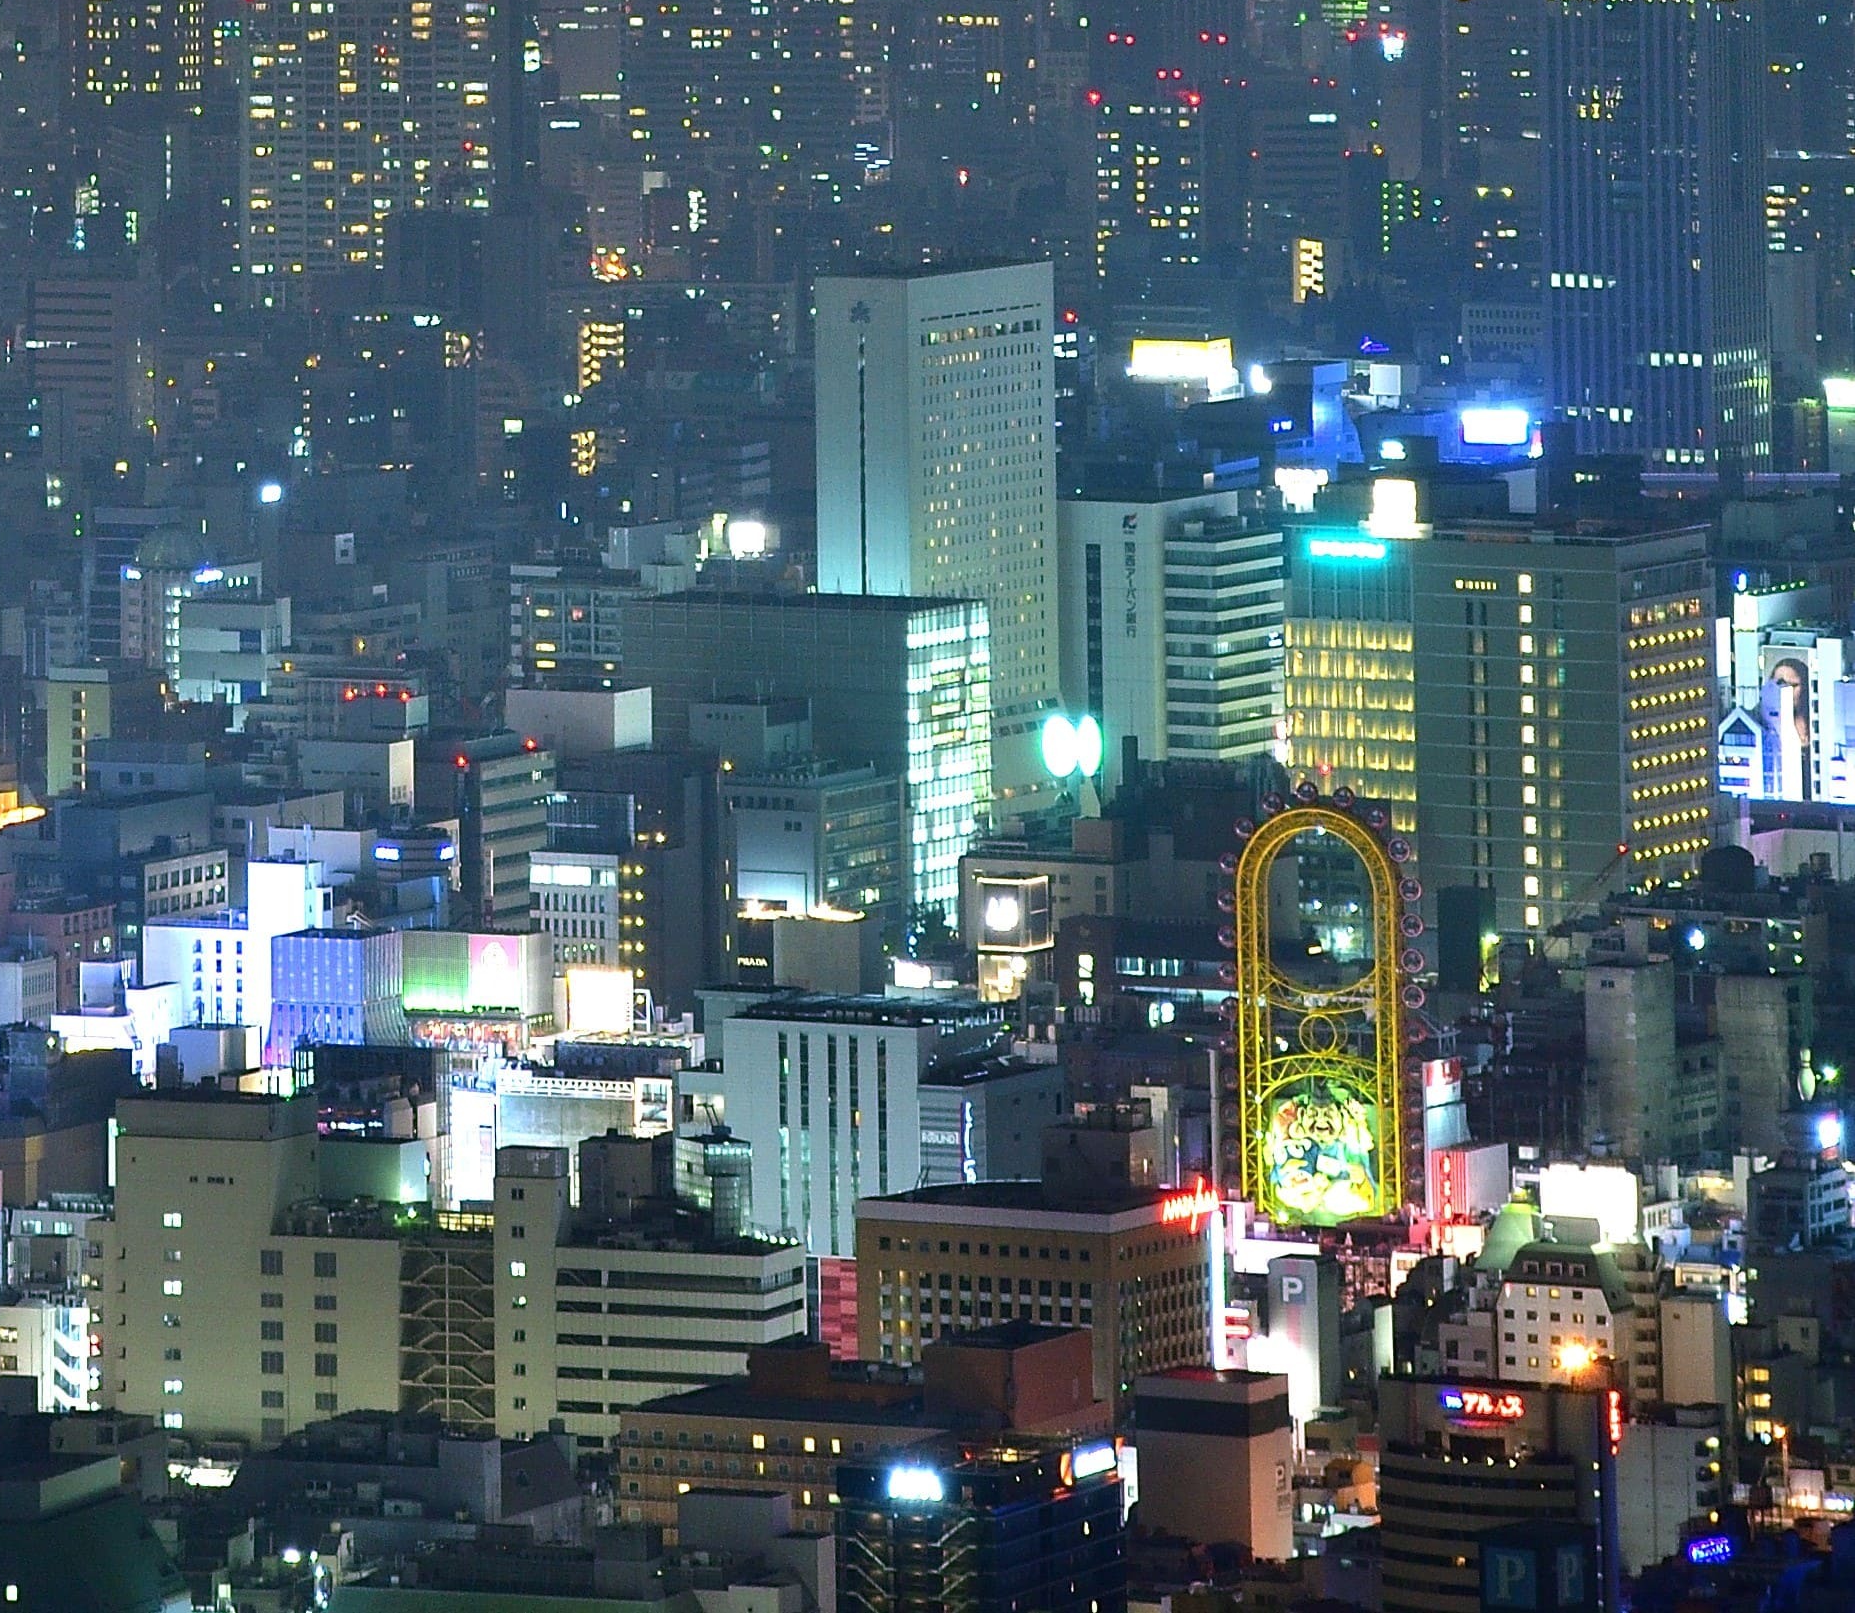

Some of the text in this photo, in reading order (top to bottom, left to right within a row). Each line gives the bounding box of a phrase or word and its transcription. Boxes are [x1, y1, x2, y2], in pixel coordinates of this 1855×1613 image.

[737, 957, 769, 967] PRADA
[1282, 1276, 1303, 1302] P
[1275, 1465, 1285, 1487] P
[1495, 1553, 1526, 1600] P
[1558, 1552, 1578, 1599] P
